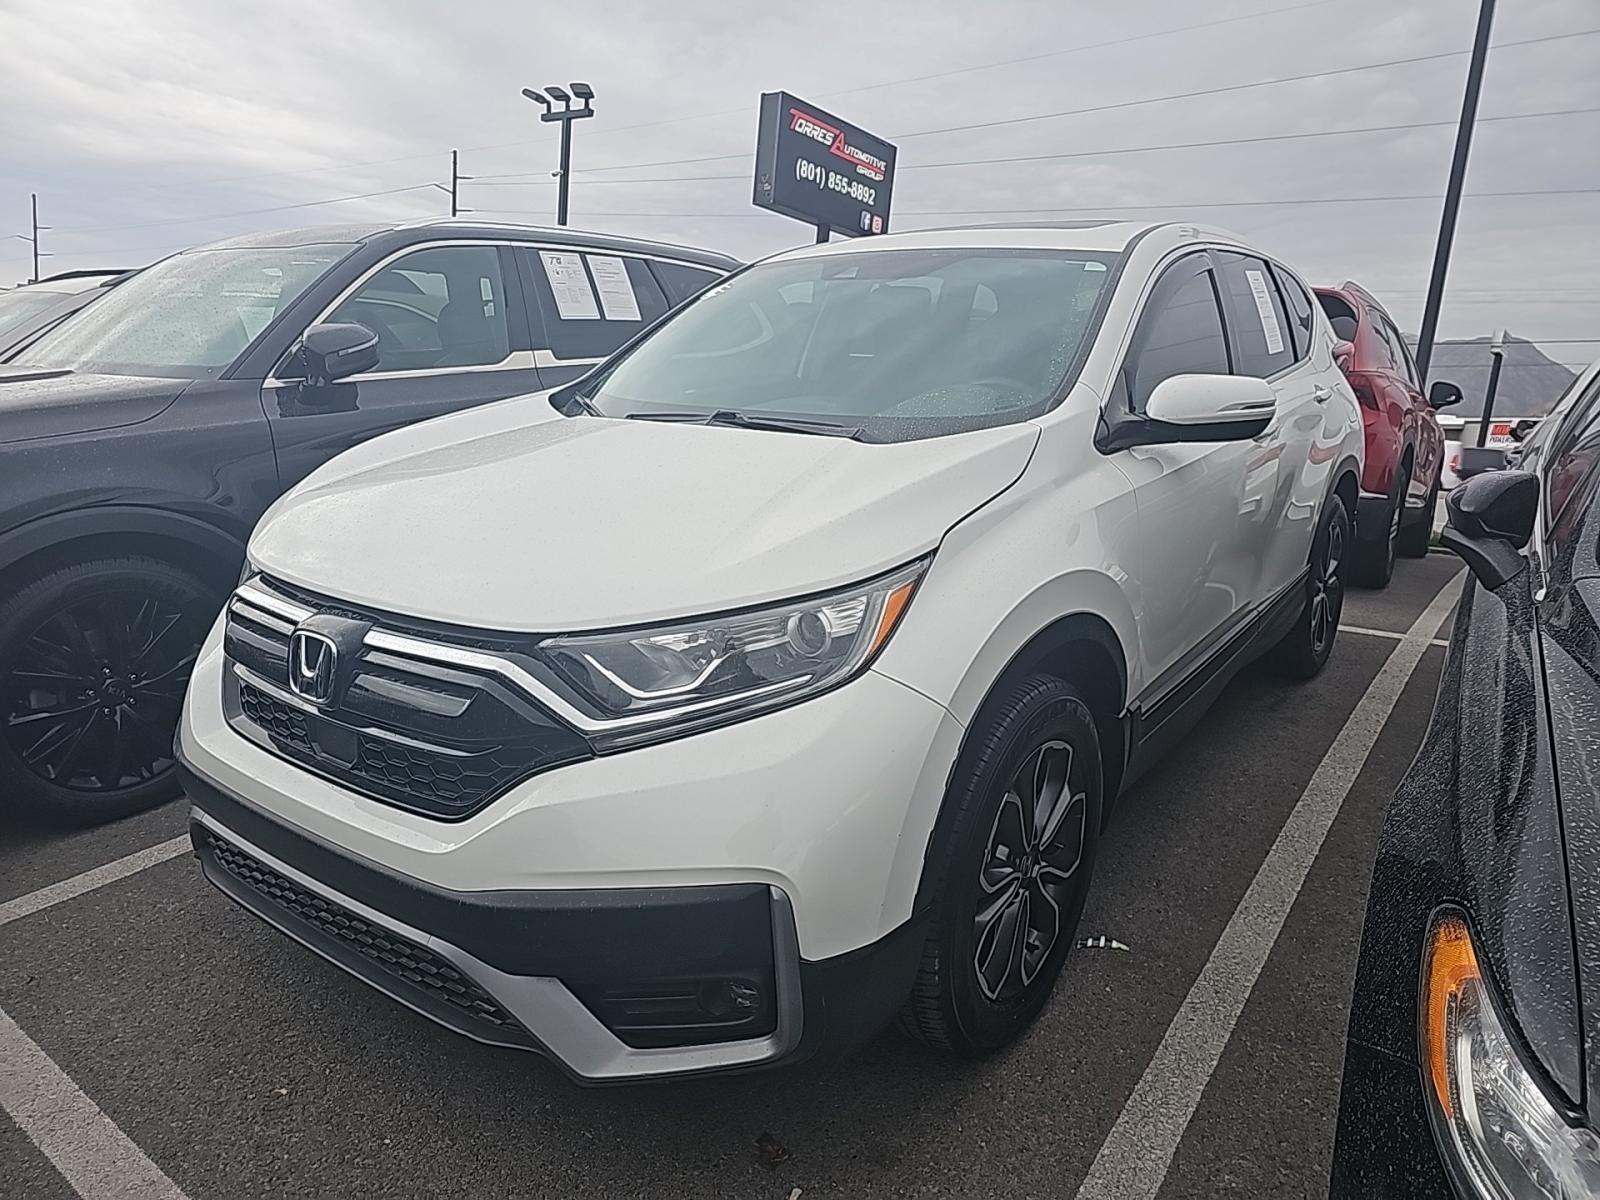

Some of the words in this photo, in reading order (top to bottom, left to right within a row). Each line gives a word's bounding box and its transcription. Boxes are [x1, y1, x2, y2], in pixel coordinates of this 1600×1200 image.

[789, 108, 839, 146] TORRES
[829, 132, 887, 173] AUTOMOTIVE
[796, 158, 826, 189] (801)
[827, 171, 876, 206] 855-8892
[856, 164, 884, 181] GROUP
